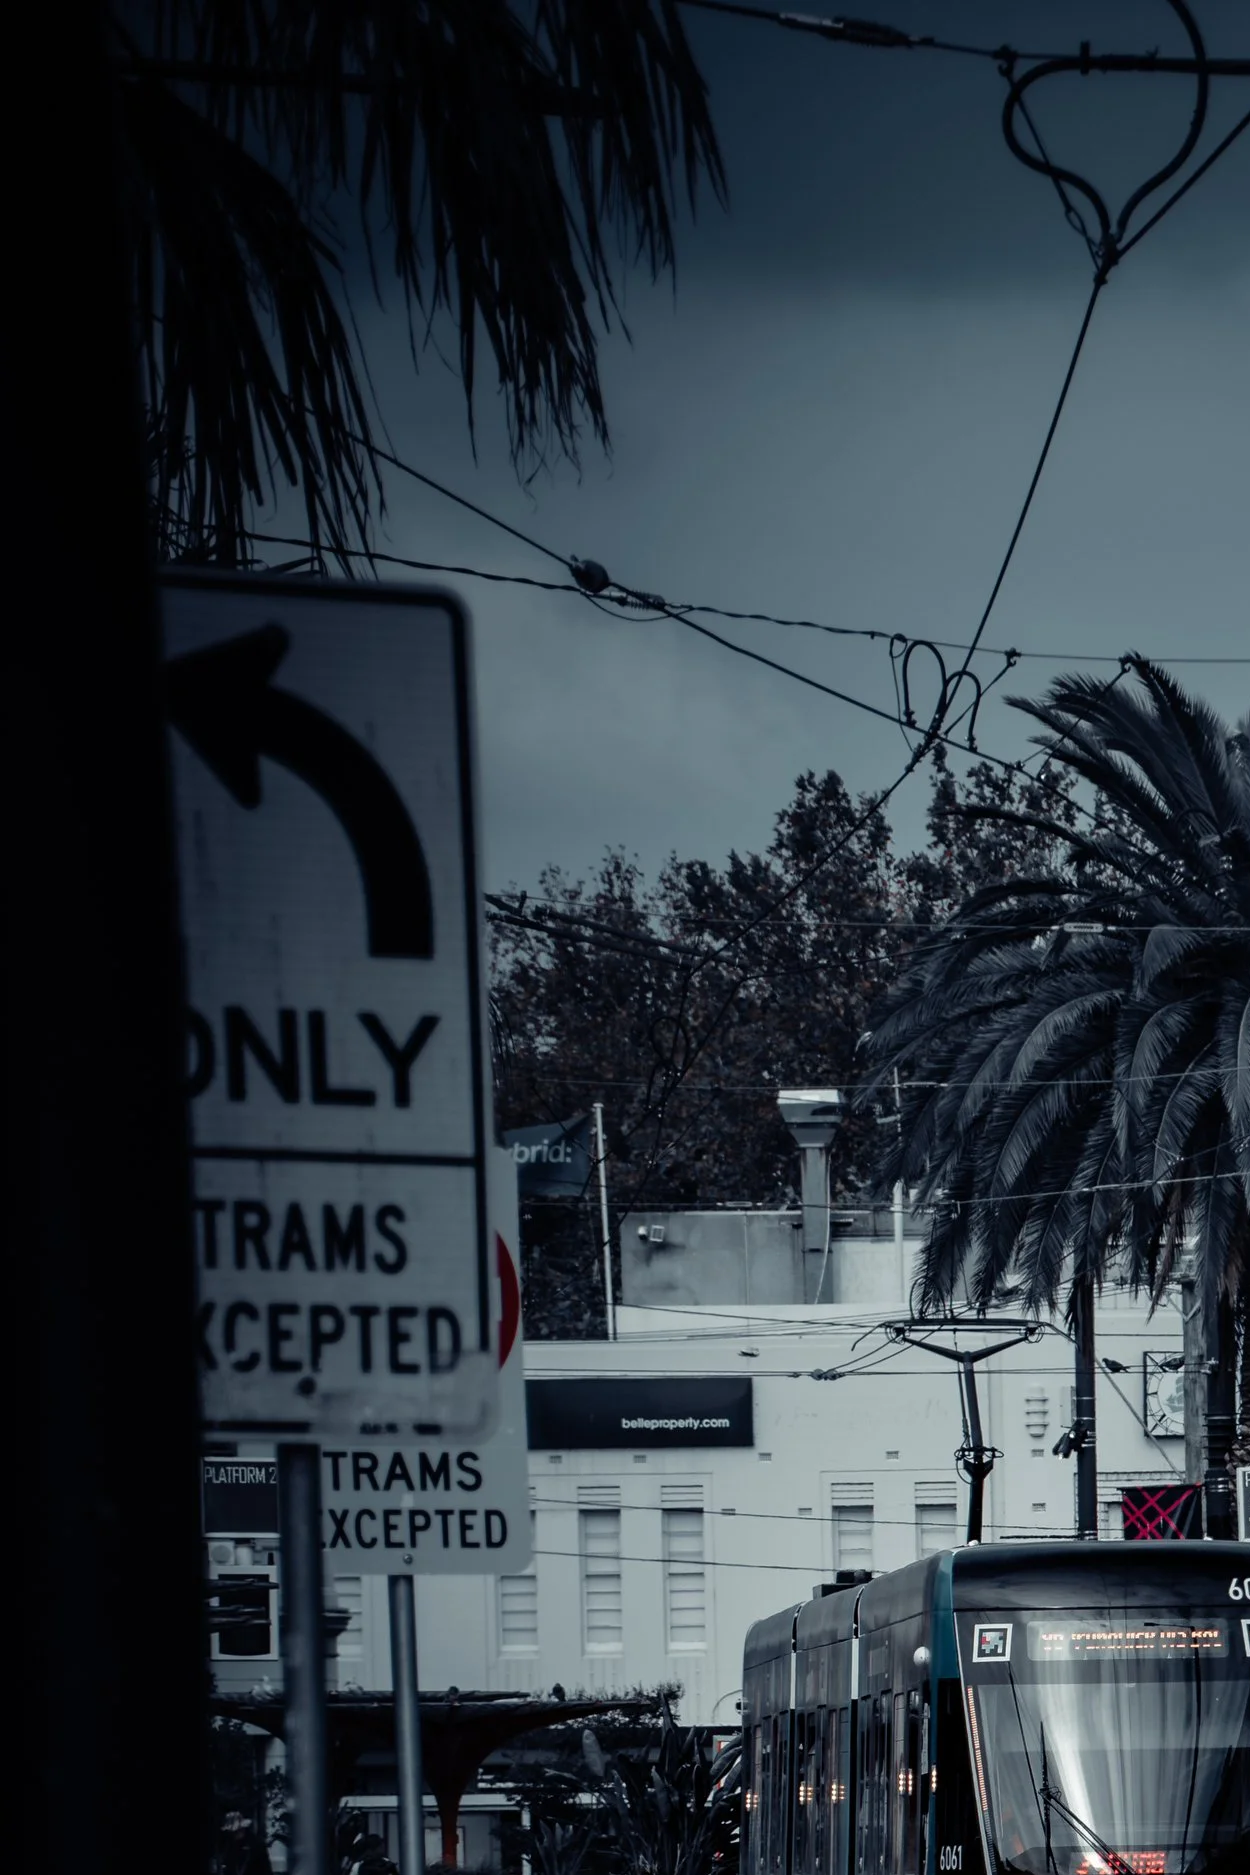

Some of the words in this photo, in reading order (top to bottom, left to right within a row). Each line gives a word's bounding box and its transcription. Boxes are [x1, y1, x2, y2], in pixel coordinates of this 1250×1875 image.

[192, 1200, 408, 1275] TRAMS
[621, 1417, 730, 1432] belleproperty.com
[203, 1466, 265, 1484] PLATFORM
[268, 1466, 277, 1484] 2
[322, 1451, 483, 1492] TRAMS
[321, 1509, 508, 1549] XCEPTED
[940, 1845, 963, 1871] 6061
